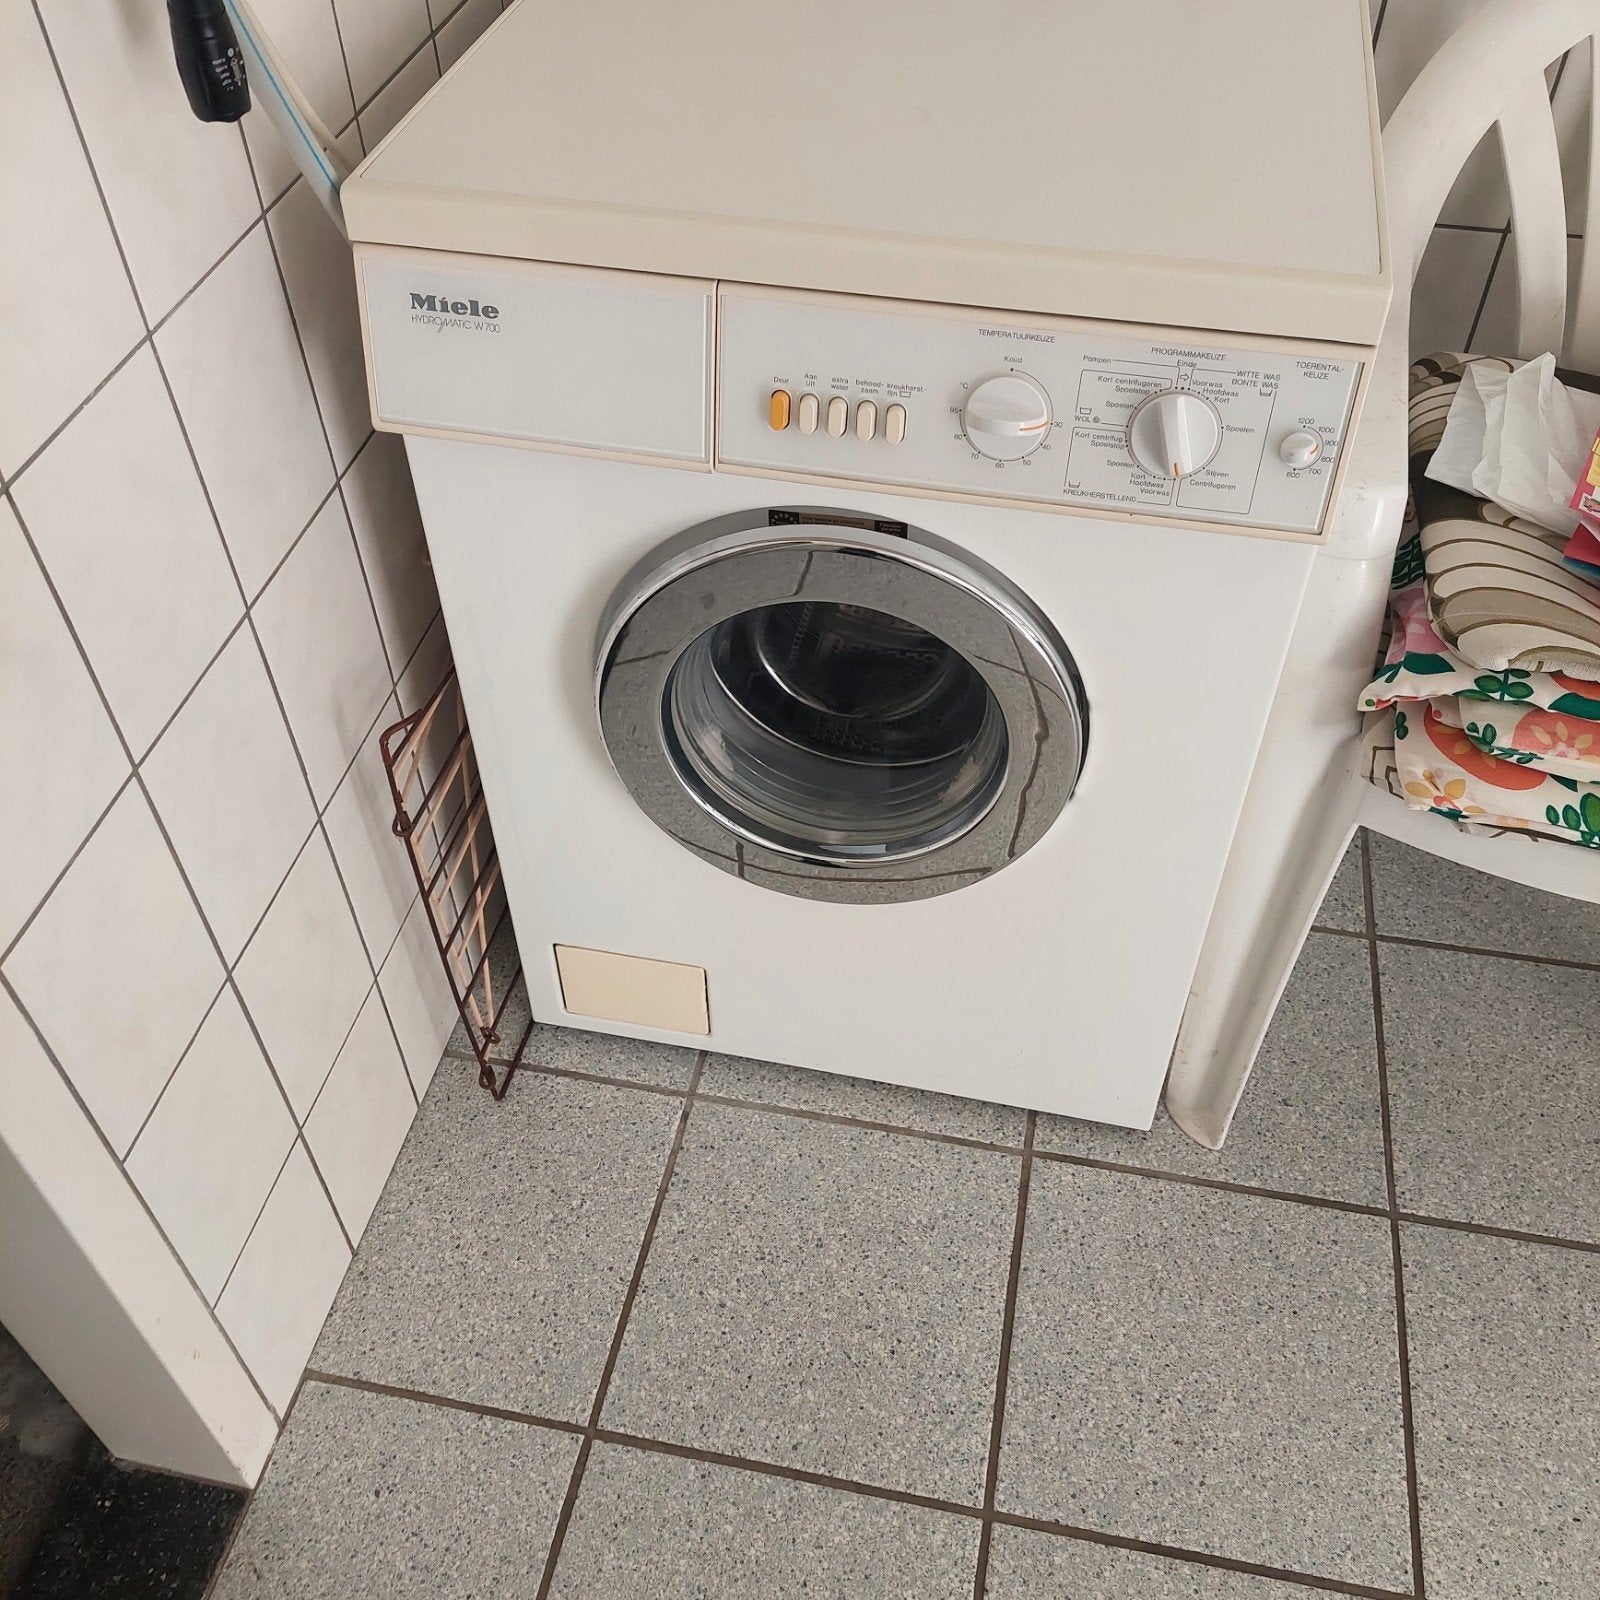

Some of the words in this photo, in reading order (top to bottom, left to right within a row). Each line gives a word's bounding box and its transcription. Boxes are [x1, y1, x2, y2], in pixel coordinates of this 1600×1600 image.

[409, 292, 499, 320] Miele
[978, 328, 1055, 344] TEMPERATUURKEUZE
[1151, 346, 1227, 361] PROGRAMMAKEUZE
[1004, 354, 1023, 364] Koud
[1176, 359, 1198, 368] Einde
[1296, 360, 1345, 373] TOERENTAL-
[803, 372, 818, 381] Aan
[1236, 369, 1260, 379] WITTE
[1263, 372, 1281, 382] WAS
[1303, 370, 1330, 380] KEUZE
[1097, 375, 1113, 384] Kort
[1115, 378, 1162, 389] centrifugeren
[1192, 379, 1223, 389] Voorwas
[1231, 378, 1258, 388] BONTE
[1261, 380, 1279, 390] WAS
[1115, 385, 1151, 396] Spoelstop
[1203, 387, 1239, 398] Hoofdwas
[1214, 395, 1230, 404] Kort
[950, 406, 959, 414] 95
[1105, 400, 1135, 411] Spoelen
[1054, 420, 1063, 428] 30
[1074, 415, 1091, 424] WOL
[1298, 417, 1315, 425] 1200
[1225, 424, 1255, 434] Spoelen
[1318, 426, 1335, 434] 1000
[1075, 431, 1091, 440] Kort
[1042, 442, 1051, 451] 40
[1090, 439, 1125, 450] Spoelstop
[971, 452, 980, 461] 70
[1320, 456, 1336, 464] 800
[1106, 459, 1135, 469] Spoelen
[1131, 472, 1146, 480] Kort
[1286, 471, 1301, 479] 600
[1308, 468, 1323, 476] 700
[1129, 479, 1165, 490] Hoofdwas
[1189, 479, 1236, 491] Centrifugeren
[1063, 488, 1137, 503] KREUKHERSTELLEND
[1140, 487, 1171, 498] Voorwas
